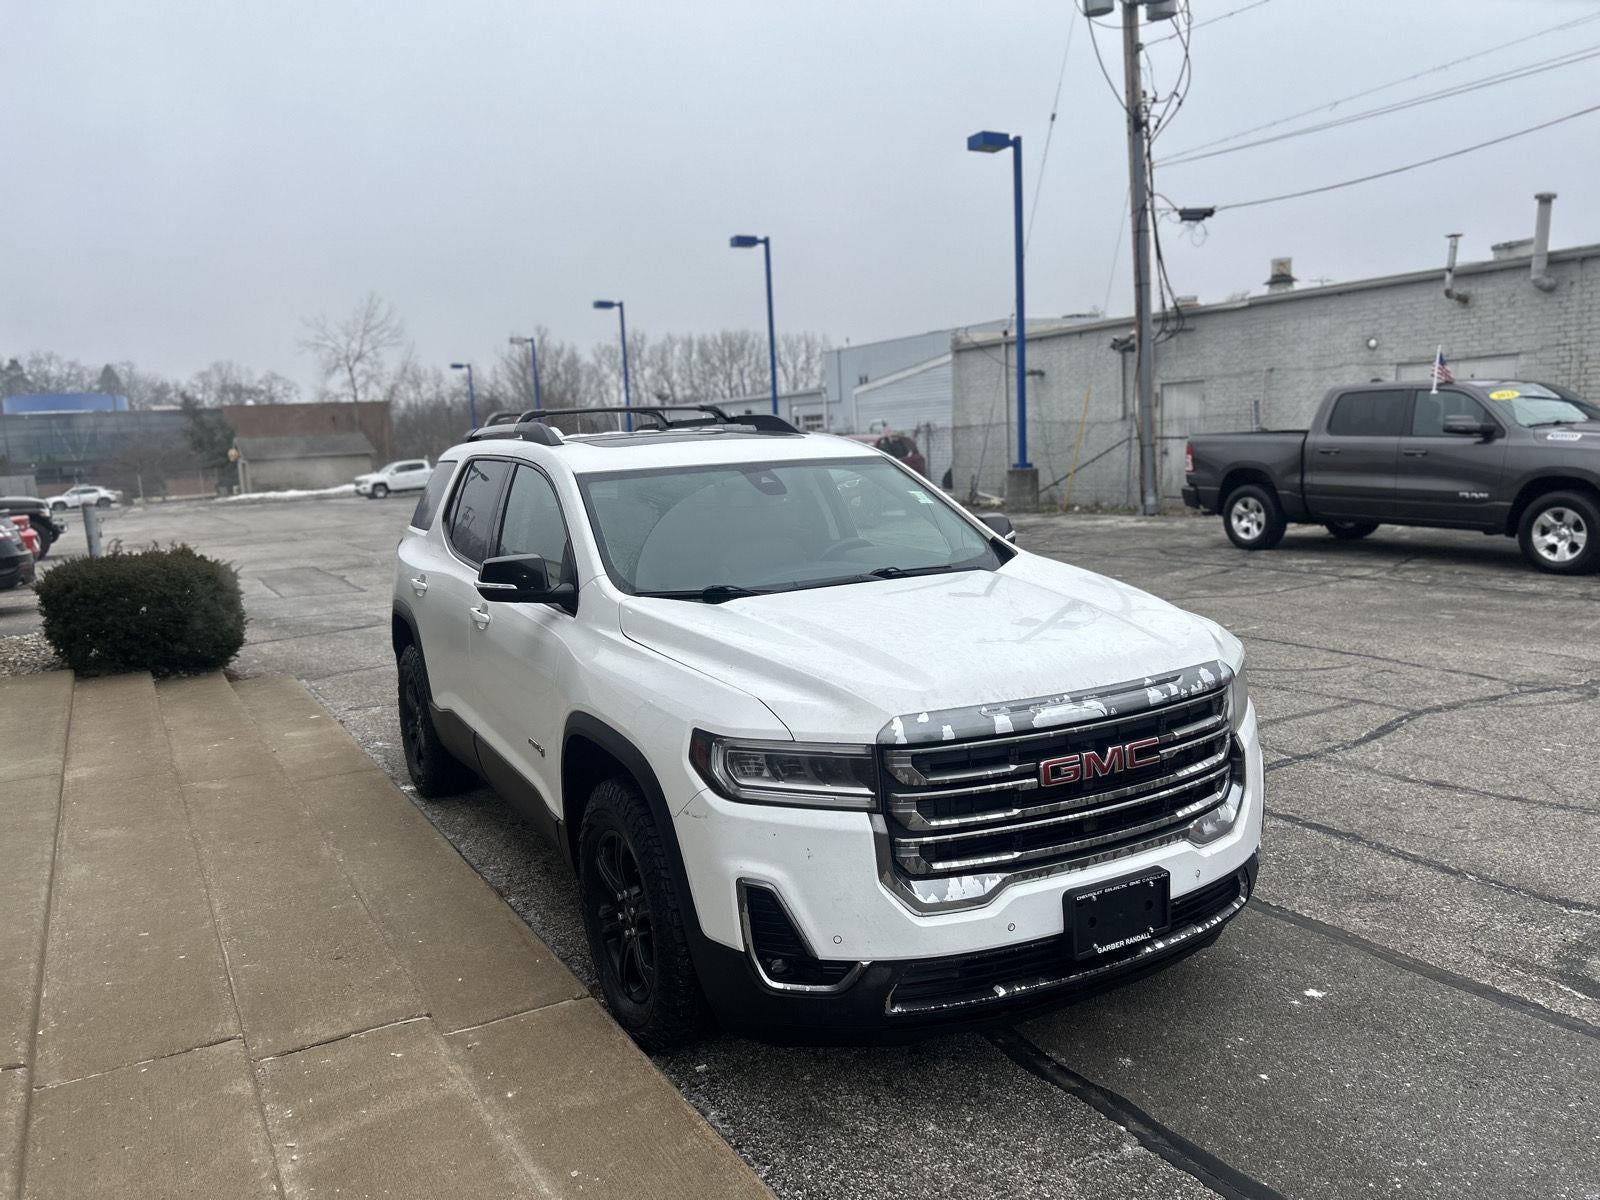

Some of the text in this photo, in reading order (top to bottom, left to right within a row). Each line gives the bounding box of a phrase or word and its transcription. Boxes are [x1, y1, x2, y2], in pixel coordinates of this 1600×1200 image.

[1040, 737, 1160, 787] GMC
[1141, 872, 1168, 883] CADILLAC
[1097, 932, 1151, 954] GARBER RANDALL
